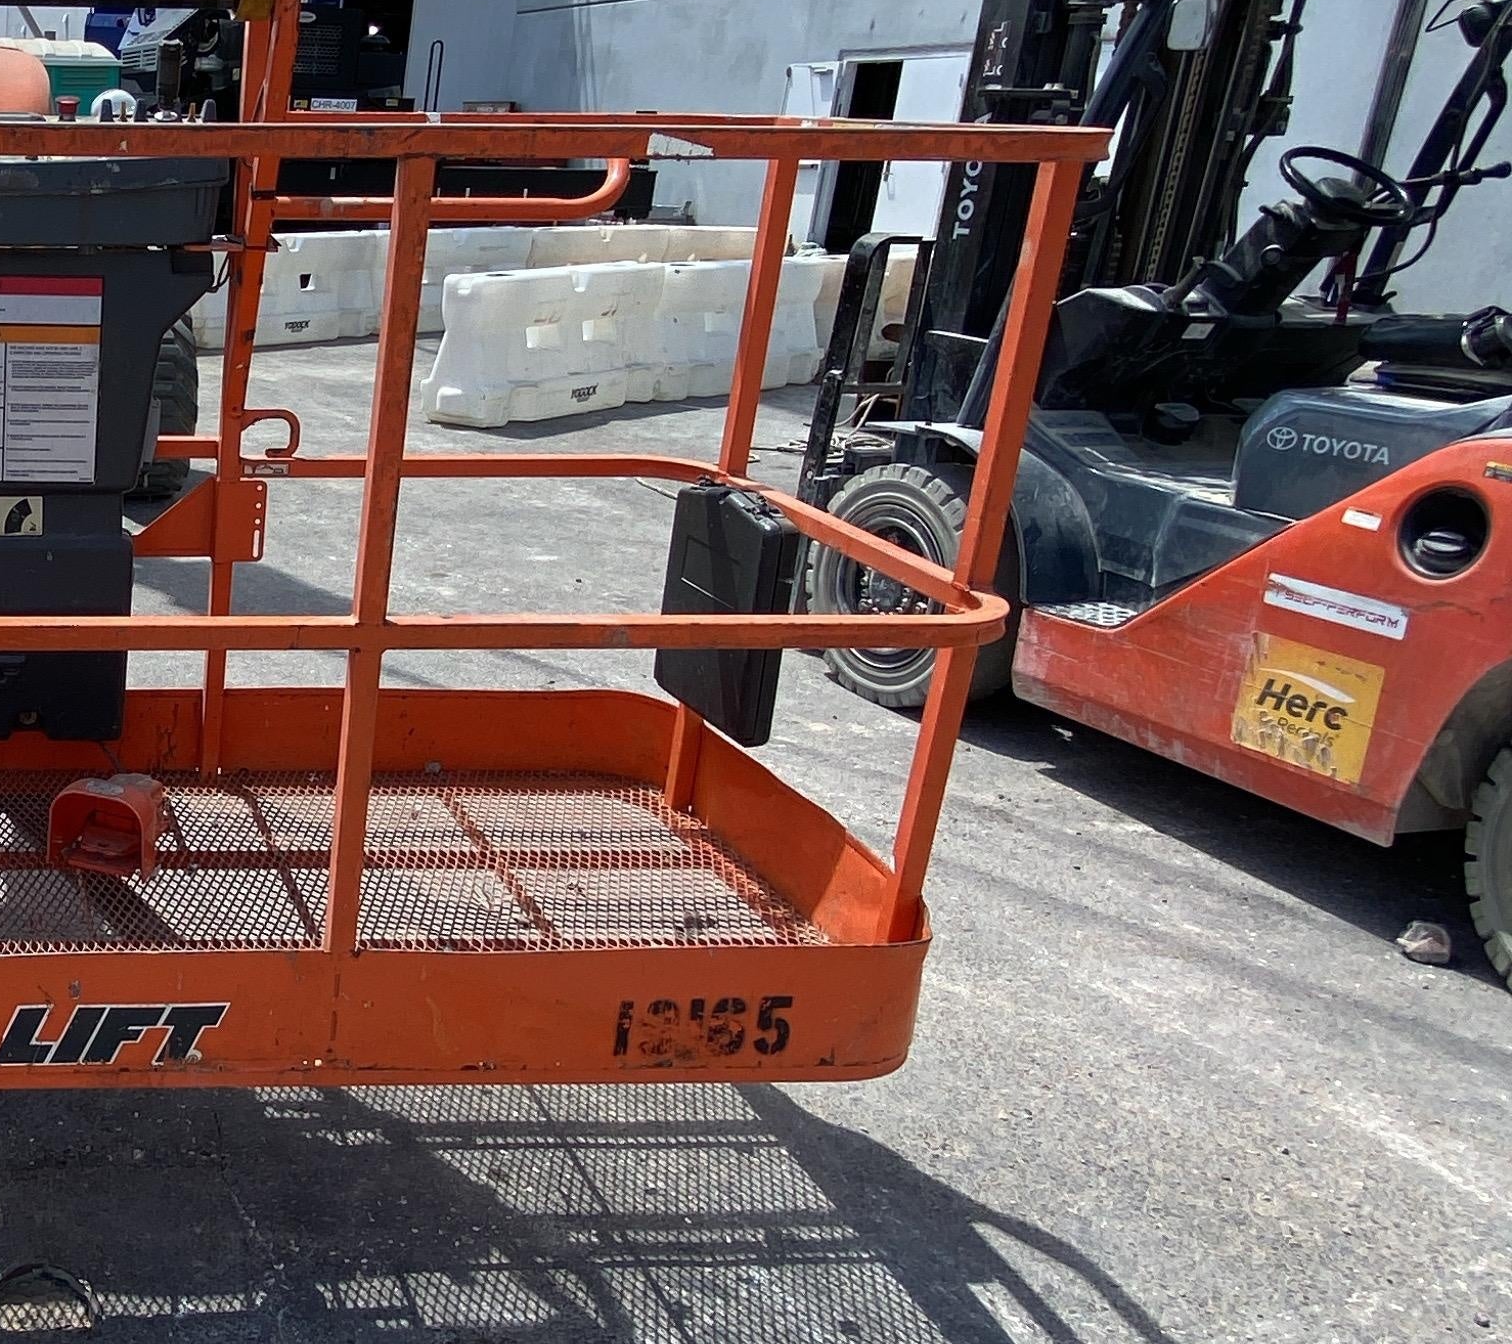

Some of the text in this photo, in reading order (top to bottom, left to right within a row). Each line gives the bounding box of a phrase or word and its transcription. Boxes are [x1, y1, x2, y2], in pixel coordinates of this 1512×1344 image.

[311, 99, 356, 110] CHR-4007
[952, 111, 993, 240] TOYOA
[1301, 434, 1389, 465] TOYOTA
[1255, 678, 1349, 731] Herc
